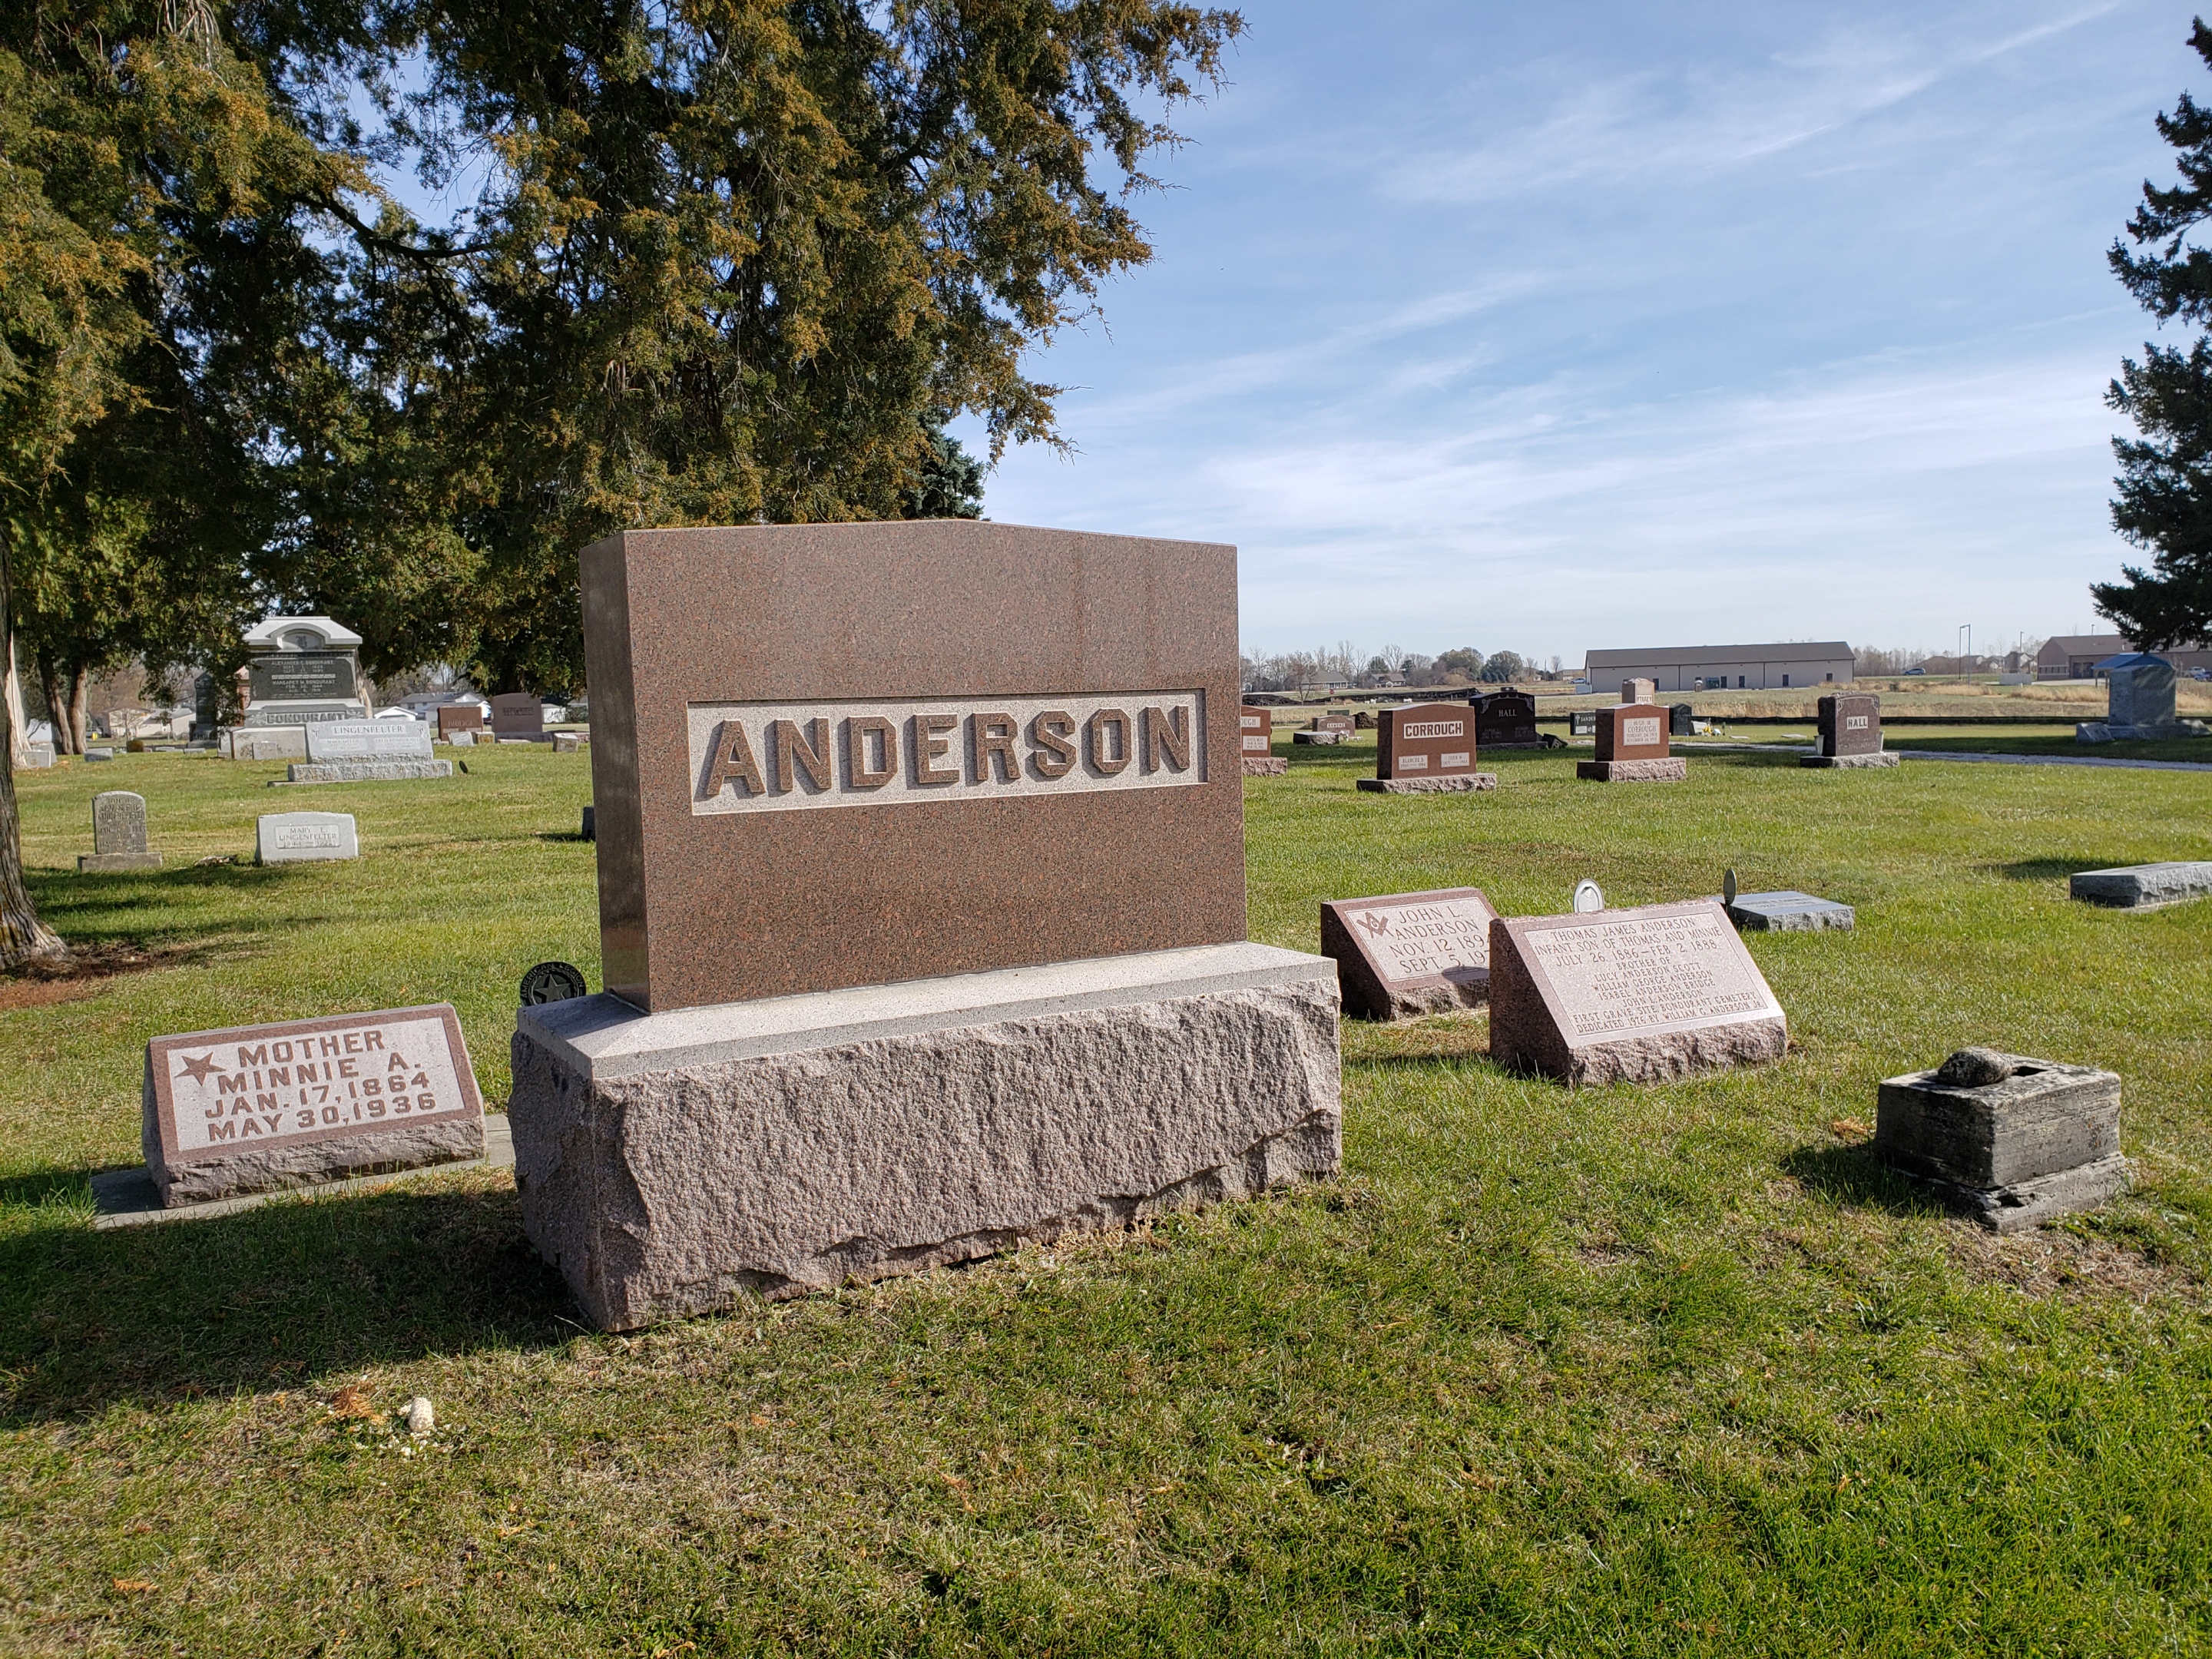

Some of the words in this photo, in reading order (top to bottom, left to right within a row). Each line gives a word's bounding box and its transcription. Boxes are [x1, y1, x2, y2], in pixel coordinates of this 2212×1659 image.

[267, 713, 345, 724] BONDURANT
[1498, 708, 1518, 717] HALL
[1848, 717, 1867, 727] HALL
[334, 726, 403, 734] LINGENFELTER
[1405, 723, 1462, 737] CORROUGH
[707, 705, 1190, 796] ANDERSON
[1398, 907, 1444, 924] JOHN
[1447, 906, 1463, 918] L.
[1395, 919, 1479, 941] ANDERSON
[1535, 943, 1573, 955] INFANT
[1577, 939, 1600, 952] SON
[1602, 938, 1616, 949] OF
[1619, 933, 1661, 947] THOMAS
[1665, 930, 1685, 942] AND
[1687, 926, 1723, 939] MINNIE
[1551, 928, 1598, 942] THOMAS
[1603, 924, 1637, 937] JAMES
[1641, 917, 1696, 933] ANDERSON
[1389, 942, 1429, 958] NOV.
[1399, 957, 1443, 973] SEPT.
[1468, 950, 1490, 965] 19
[1556, 954, 1583, 967] JULY
[1611, 948, 1639, 961] 1886
[1690, 939, 1717, 952] 1888
[1594, 972, 1618, 982] LUCY
[1622, 966, 1670, 979] ANDERSON
[1672, 962, 1701, 972] SCOTT
[1616, 958, 1657, 970] BROTHER
[1660, 956, 1671, 965] OF
[521, 963, 555, 998] AMERICAN
[559, 963, 584, 988] LEGION
[1591, 981, 1630, 992] WILLIAM
[1632, 976, 1667, 988] GEORGE
[1670, 969, 1714, 982] ANDERSON
[1598, 989, 1632, 1001] ISABEL
[1635, 982, 1681, 997] ANDERSON
[1684, 978, 1716, 990] BRIDGE
[1573, 1012, 1600, 1023] FIRST
[1603, 1008, 1634, 1019] GRAVE
[1660, 997, 1712, 1012] BONDURANT
[1714, 991, 1757, 1005] CEMETERY
[1622, 998, 1647, 1008] JOHN
[1576, 1019, 1624, 1033] DEDICATED
[1628, 1016, 1647, 1026] 1976
[1648, 1014, 1660, 1023] BY
[1661, 1009, 1697, 1020] WILLIAM
[1710, 1001, 1750, 1015] ANDERSON
[238, 1029, 385, 1068] MOTHER
[217, 1057, 359, 1095] MINNIE
[388, 1052, 422, 1072] A.
[205, 1092, 290, 1119] JAN.
[208, 1113, 283, 1142] MAY
